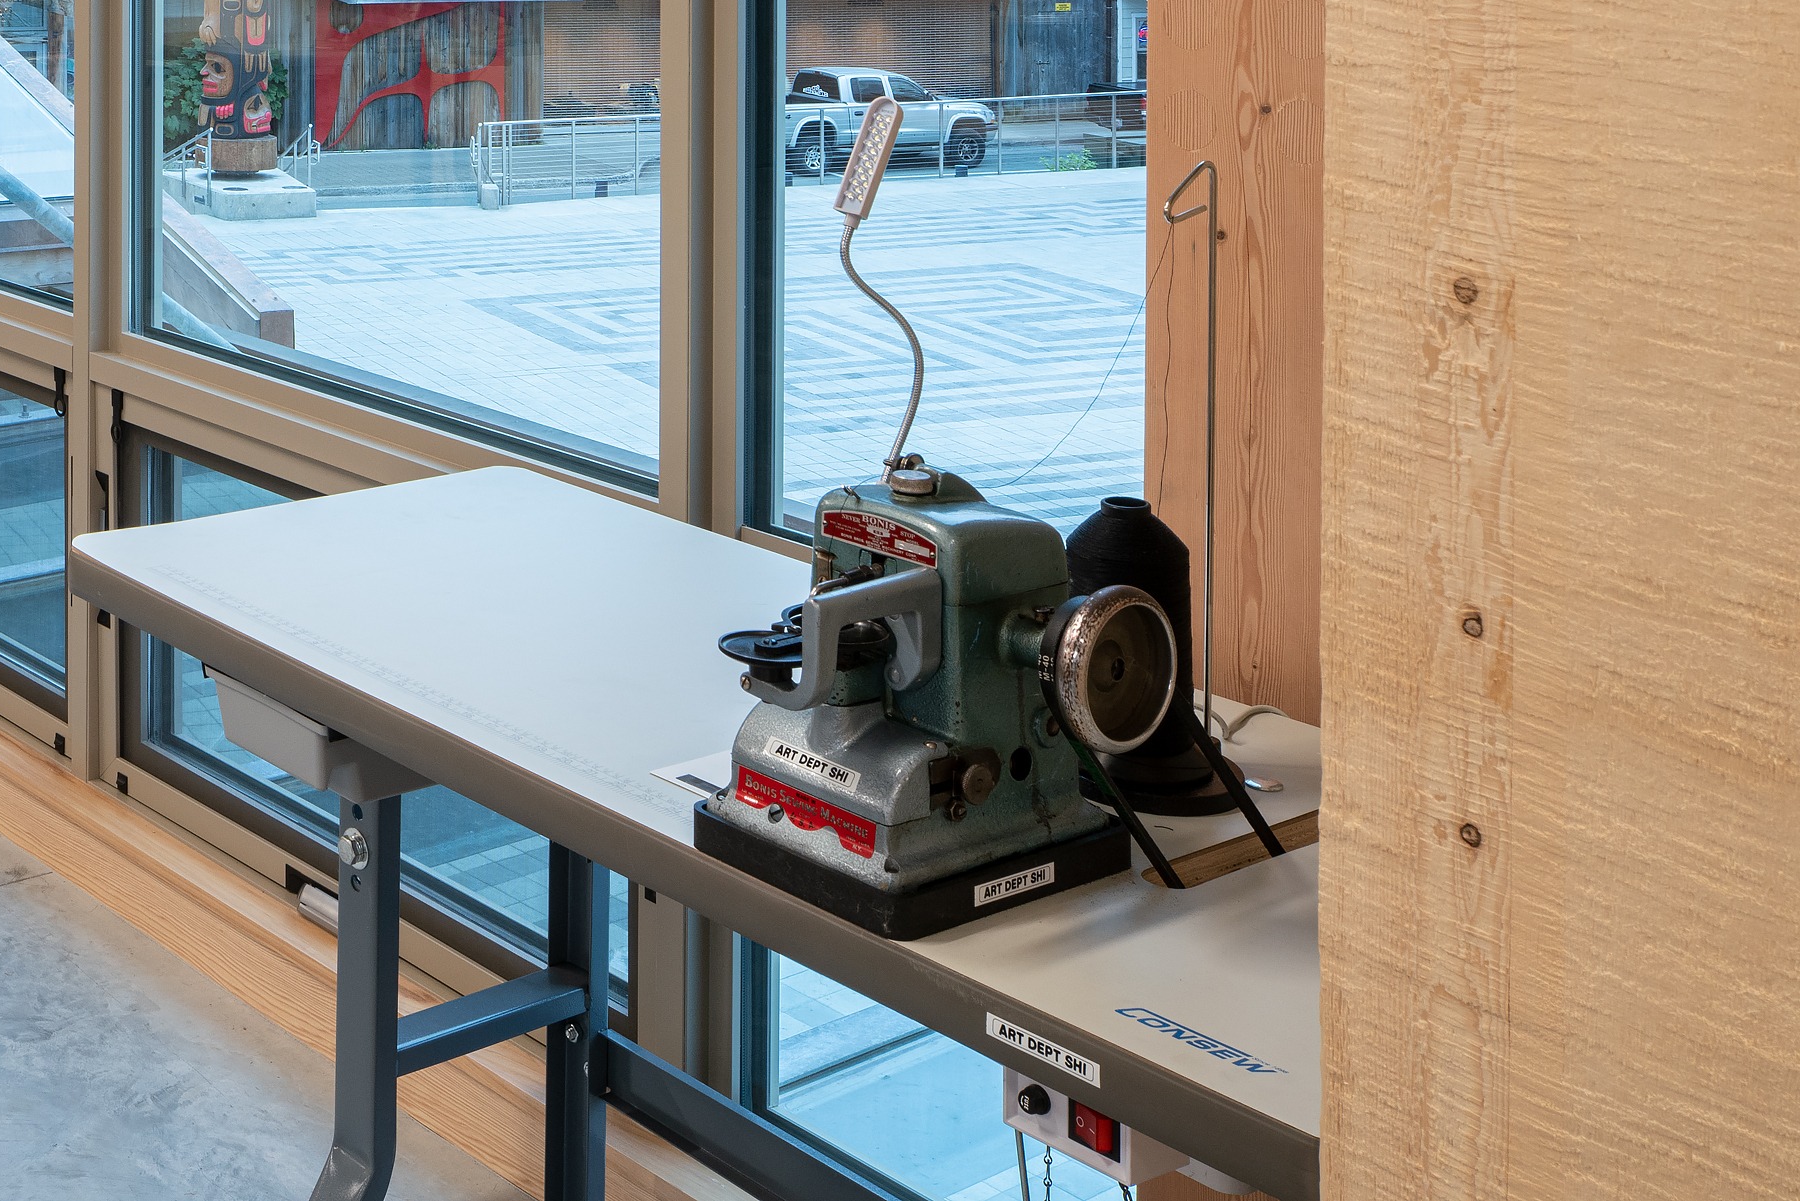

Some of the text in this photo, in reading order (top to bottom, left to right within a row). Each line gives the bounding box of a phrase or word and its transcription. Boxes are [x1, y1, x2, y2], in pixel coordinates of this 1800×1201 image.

[841, 513, 861, 523] NEVER
[862, 514, 896, 531] BONIS
[900, 531, 916, 539] STOP
[1042, 655, 1050, 681] M-40
[775, 744, 849, 783] ART DEPT SHI
[745, 774, 777, 799] BONIS
[779, 789, 818, 816] SEWING
[820, 806, 869, 839] MACHINE
[983, 869, 1046, 899] ART DEPT SHI
[999, 1024, 1087, 1076] ART DEPT SHI
[1114, 1007, 1278, 1074] CONSEW
